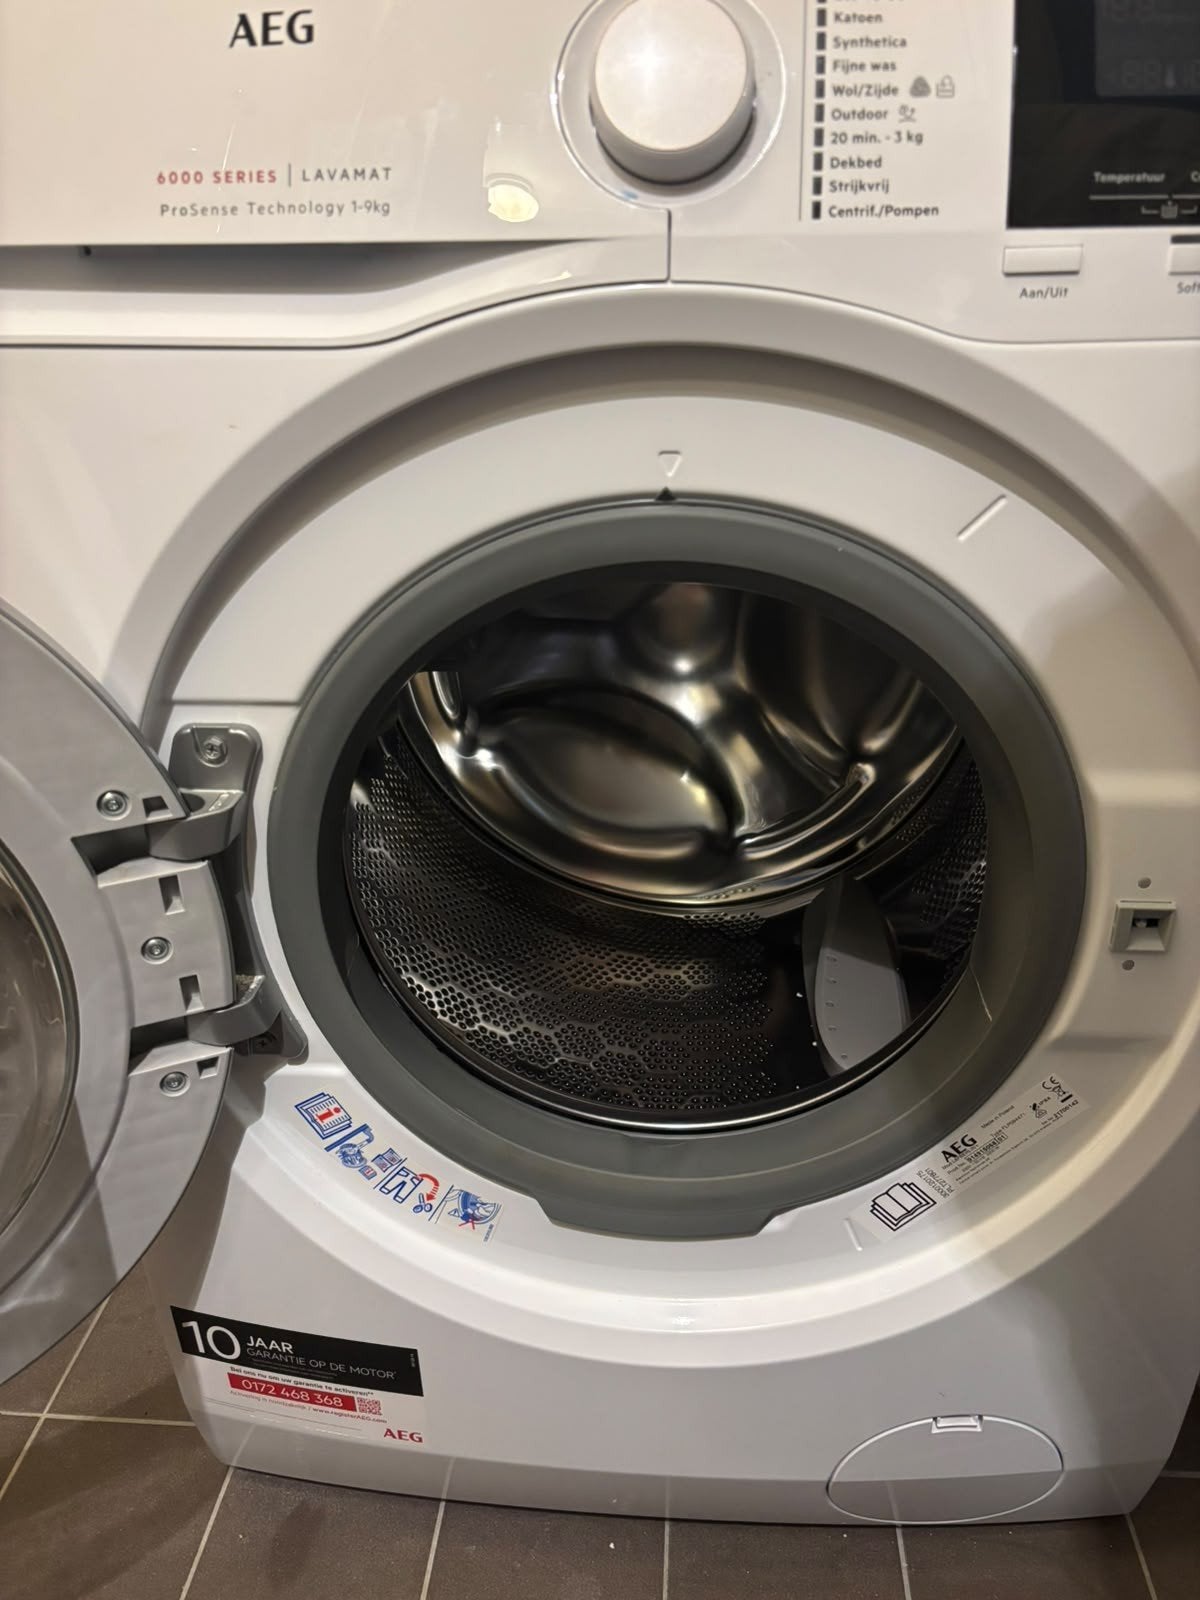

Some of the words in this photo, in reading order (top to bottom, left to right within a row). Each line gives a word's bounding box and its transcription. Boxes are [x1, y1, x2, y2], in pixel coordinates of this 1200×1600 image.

[833, 12, 883, 24] Katoen
[228, 10, 314, 48] AEG
[833, 36, 907, 49] Synthetica
[832, 59, 866, 74] Fijne
[870, 61, 896, 71] was
[832, 86, 899, 98] Wol/Zijde
[831, 108, 888, 121] Outdoor
[831, 131, 848, 145] 20
[852, 131, 881, 144] min.
[894, 130, 902, 143] 3
[906, 130, 924, 146] kg
[830, 155, 882, 169] Dekbed
[157, 171, 204, 185] 6000
[212, 170, 277, 184] SERIES
[302, 167, 392, 182] LAVAMAT
[1093, 171, 1165, 184] Temperatuur
[829, 179, 890, 195] Strijkvrij
[160, 203, 239, 217] ProSense
[247, 201, 345, 216] Technology
[351, 201, 391, 216] 1-9kg
[828, 204, 939, 219] Centrif./Pompen
[1019, 286, 1068, 299] Aan/Uit
[941, 1134, 978, 1163] AEG
[182, 1321, 241, 1360] 10
[246, 1336, 294, 1354] JAAR
[246, 1347, 306, 1366] GARANTIE
[309, 1359, 326, 1369] OP
[329, 1362, 347, 1373] DE
[293, 1380, 323, 1389] garantie
[241, 1380, 277, 1395] 0172
[281, 1388, 310, 1401] 468
[314, 1393, 344, 1407] 368
[383, 1428, 424, 1443] AEG
